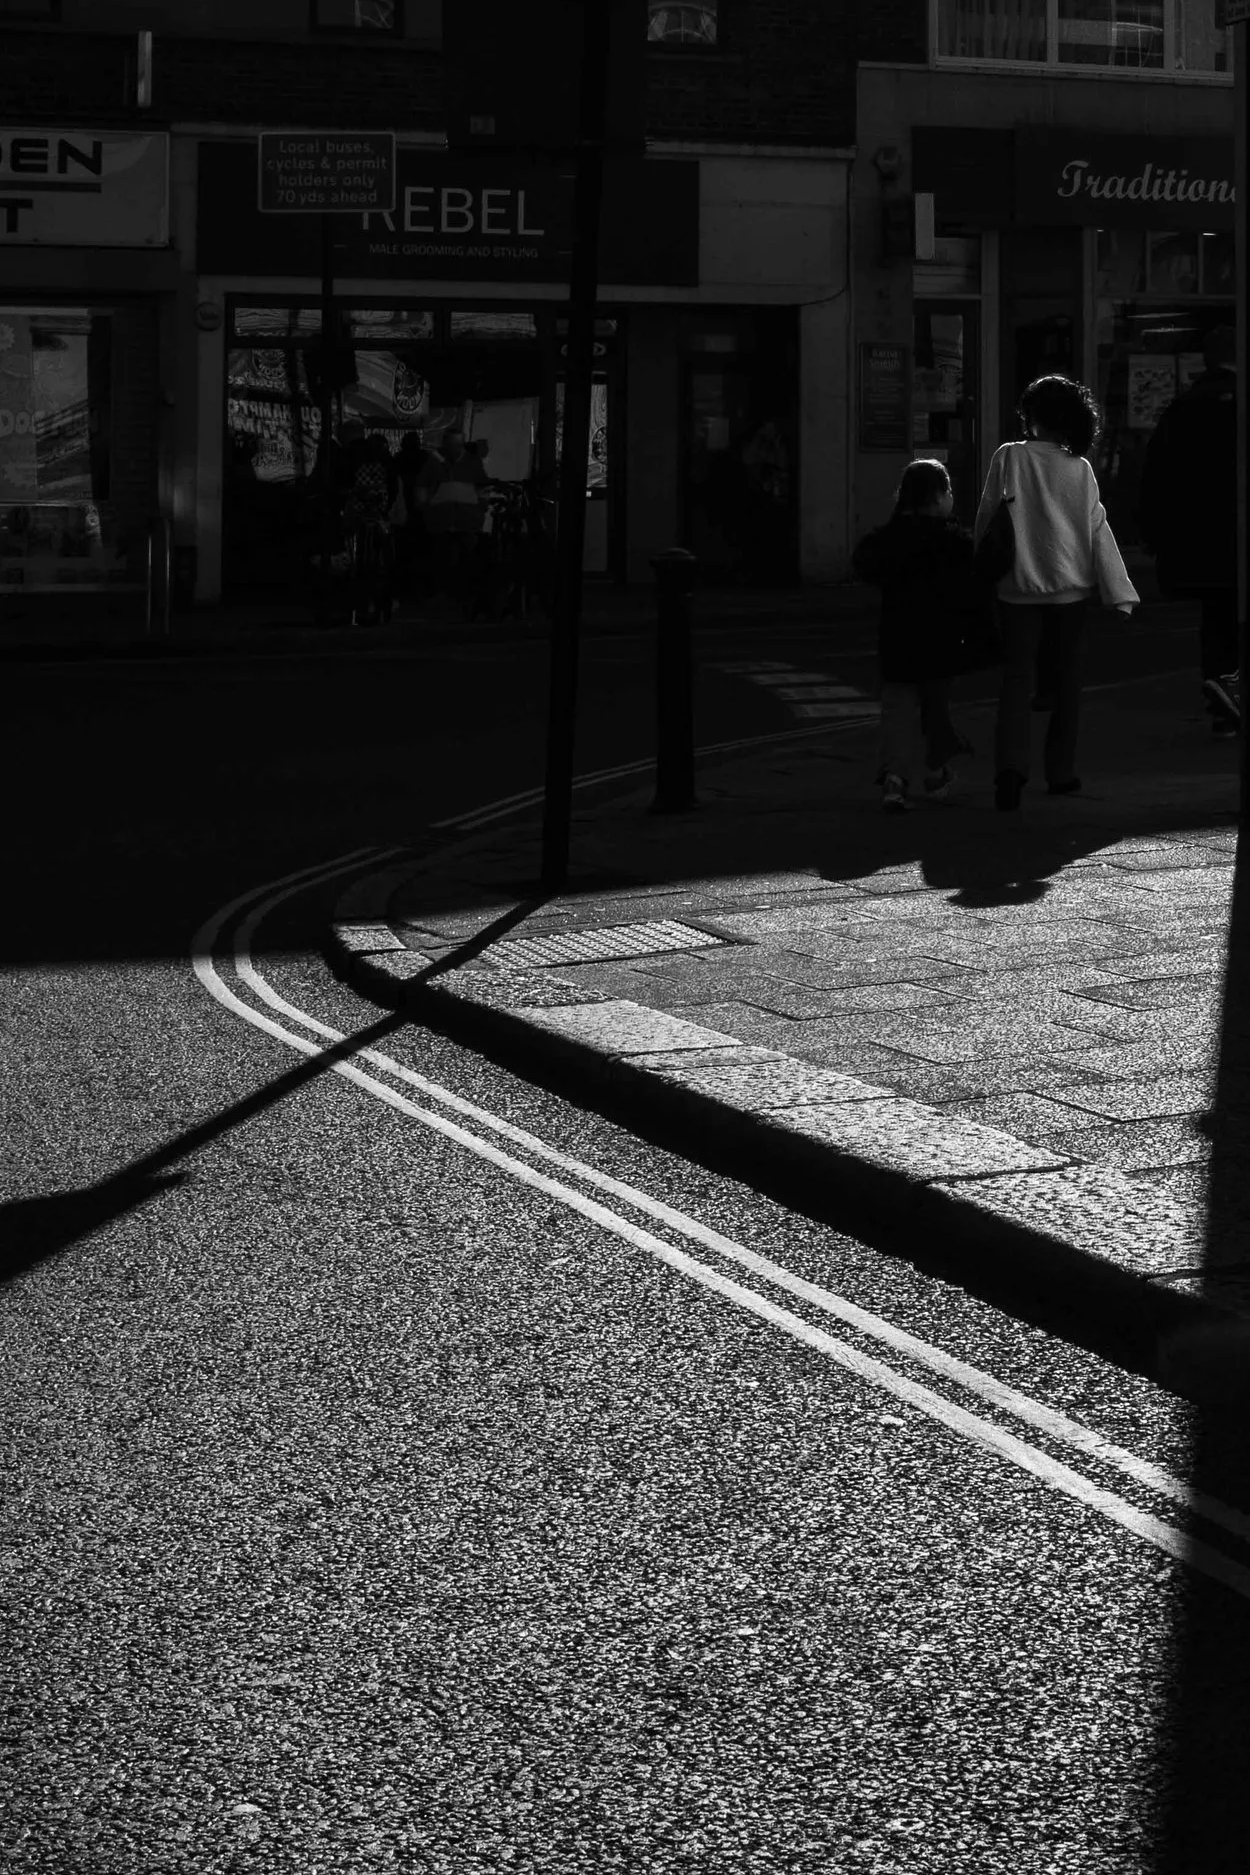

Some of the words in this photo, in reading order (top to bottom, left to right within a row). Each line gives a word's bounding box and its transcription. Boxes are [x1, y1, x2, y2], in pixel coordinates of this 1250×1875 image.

[279, 139, 319, 153] Local
[0, 138, 102, 175] EN
[265, 157, 315, 172] cycles
[321, 156, 330, 169] &
[336, 157, 387, 172] permit
[279, 173, 337, 187] holders
[342, 173, 375, 188] only
[1057, 160, 1236, 203] Tradition
[276, 189, 296, 203] 70
[300, 189, 325, 205] yds
[331, 189, 377, 203] ahead
[369, 244, 399, 255] MALE
[402, 244, 463, 257] GROOMING
[466, 246, 490, 257] AND
[493, 246, 538, 258] STYLING
